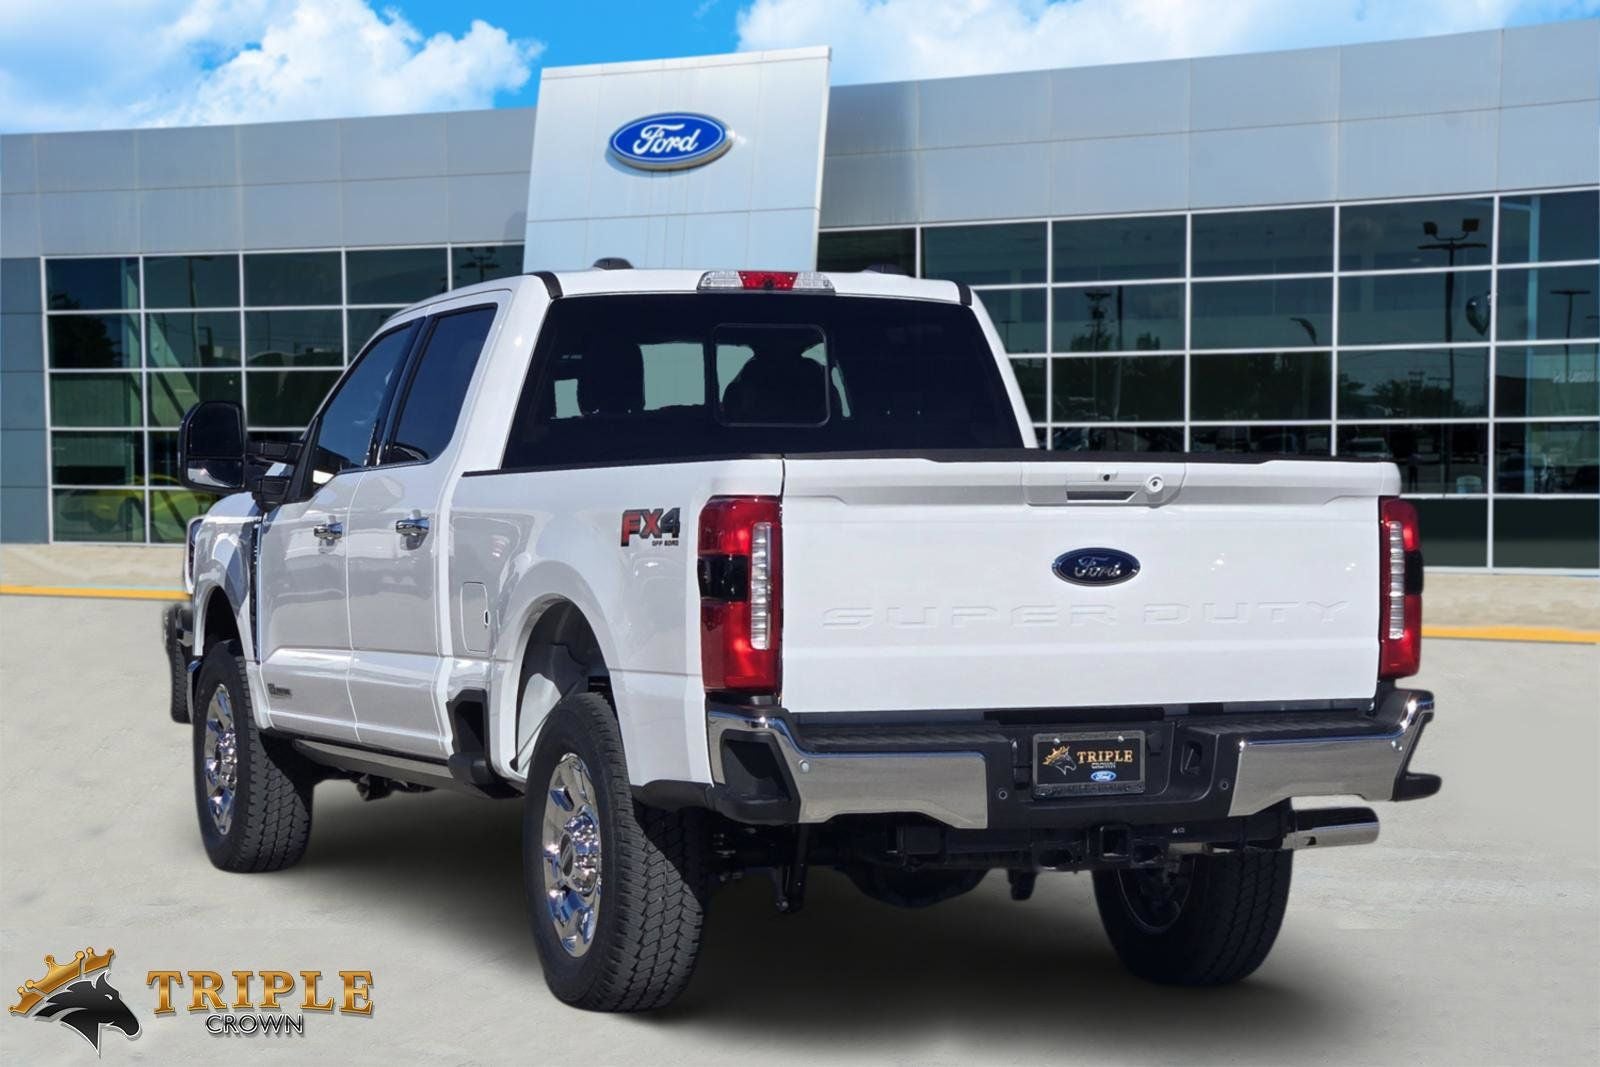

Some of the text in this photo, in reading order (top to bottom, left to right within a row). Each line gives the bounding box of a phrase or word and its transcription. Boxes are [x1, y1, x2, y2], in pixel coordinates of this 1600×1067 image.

[632, 123, 701, 155] Ford
[620, 507, 681, 547] FX4
[1074, 556, 1121, 577] Ford
[822, 600, 1351, 629] SUPER DUTY
[1077, 750, 1133, 763] TRIPLE
